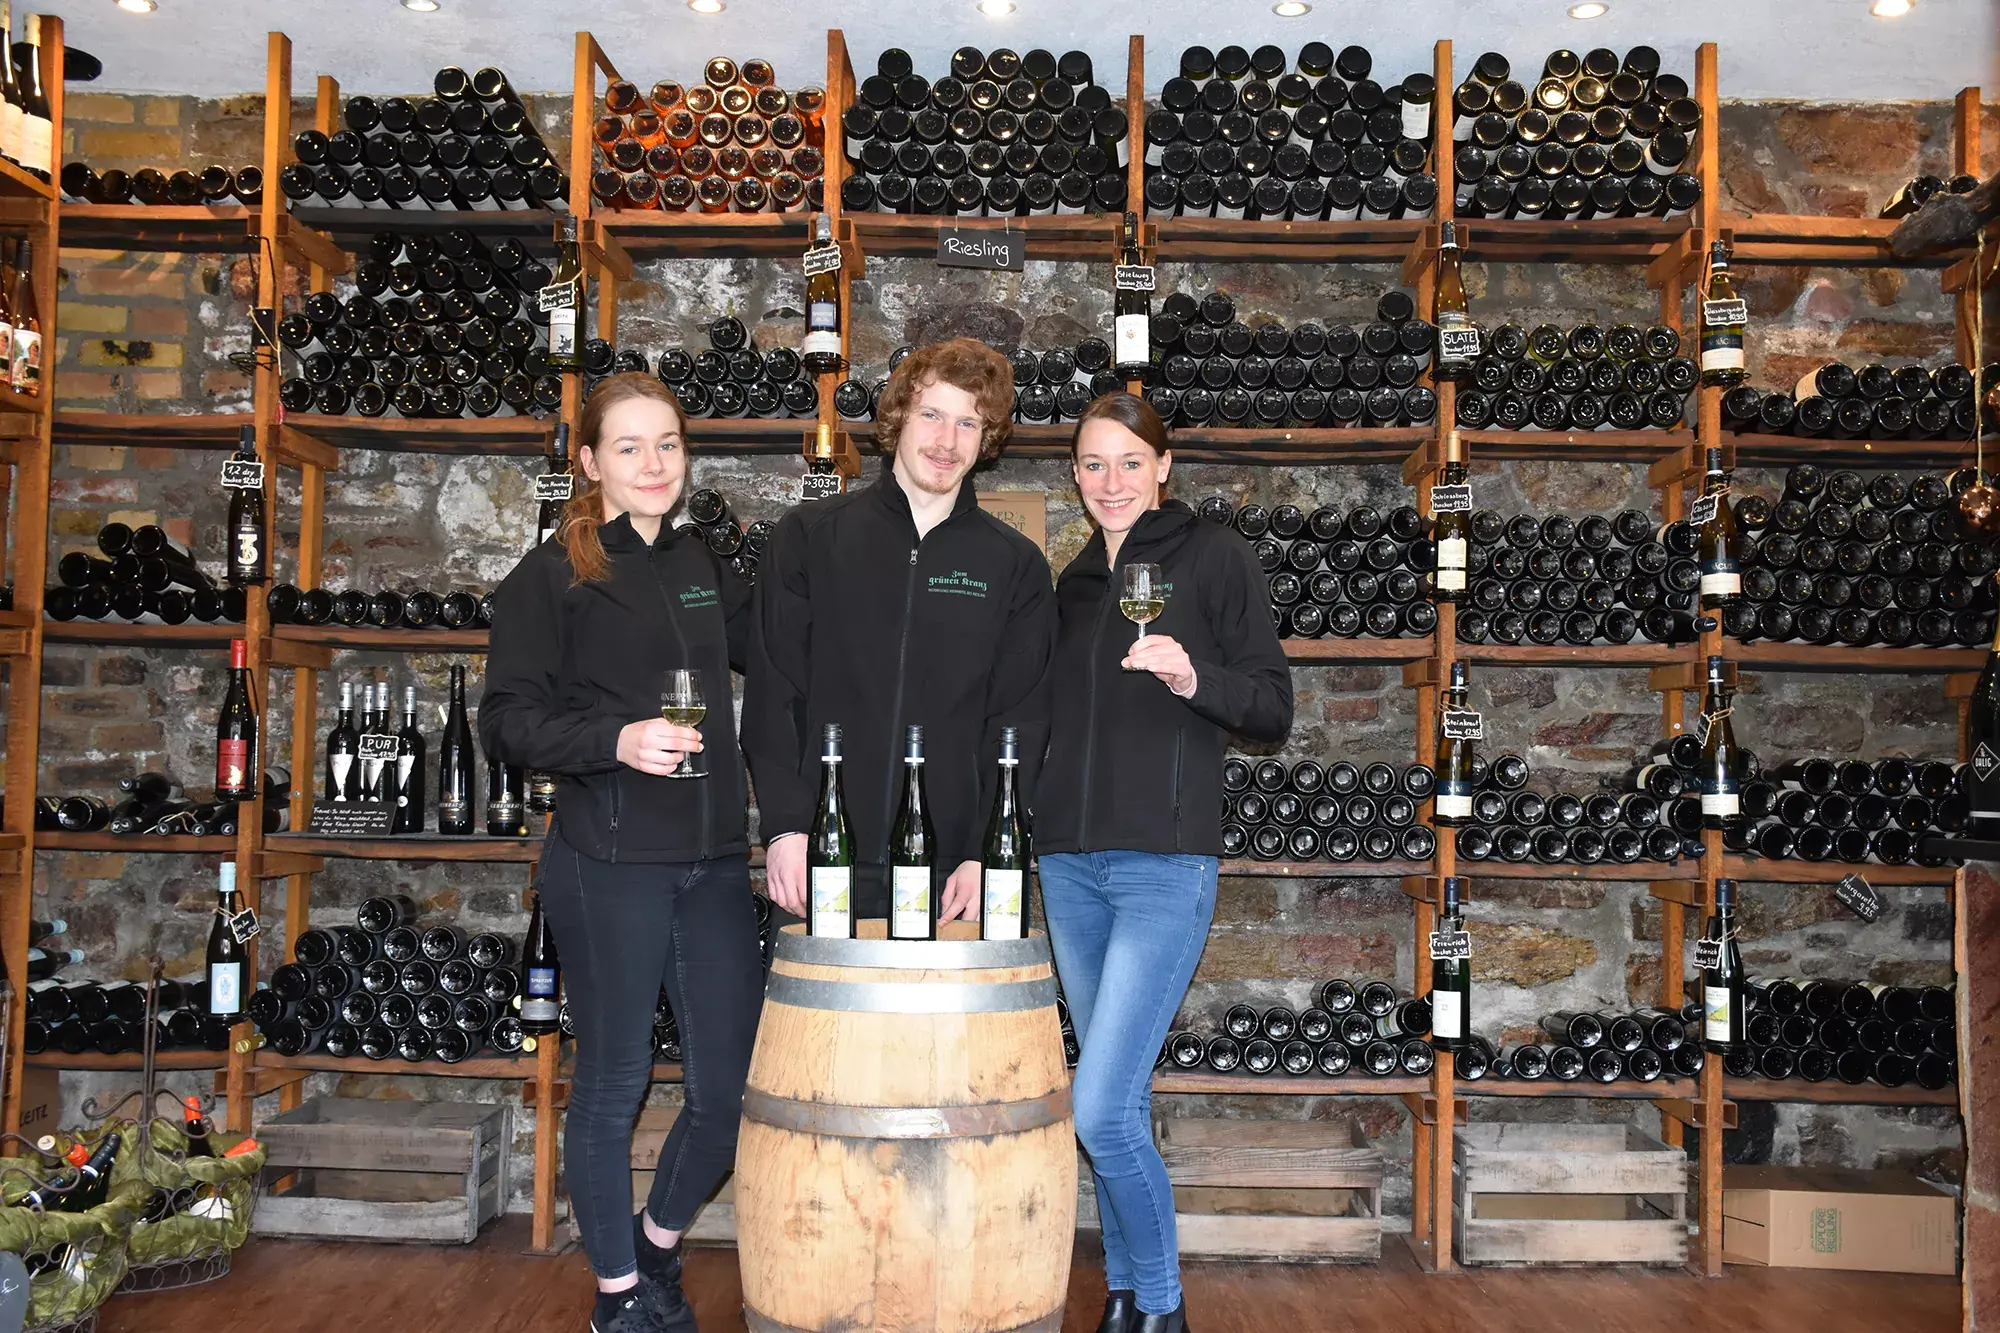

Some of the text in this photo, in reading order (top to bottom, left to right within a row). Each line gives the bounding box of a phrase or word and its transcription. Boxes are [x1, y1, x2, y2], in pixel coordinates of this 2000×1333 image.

[943, 238, 1009, 267] Riesling
[1117, 270, 1150, 281] Stielweg
[1444, 332, 1475, 345] SLATE
[226, 465, 255, 478] 1,2 dry
[951, 569, 968, 578] Zum
[928, 575, 988, 592] grünen Kranz
[366, 738, 392, 750] PUR
[1841, 878, 1879, 911] Margarethe
[1817, 1207, 1826, 1253] EXPLORE
[1826, 1207, 1836, 1253] RIESLING
